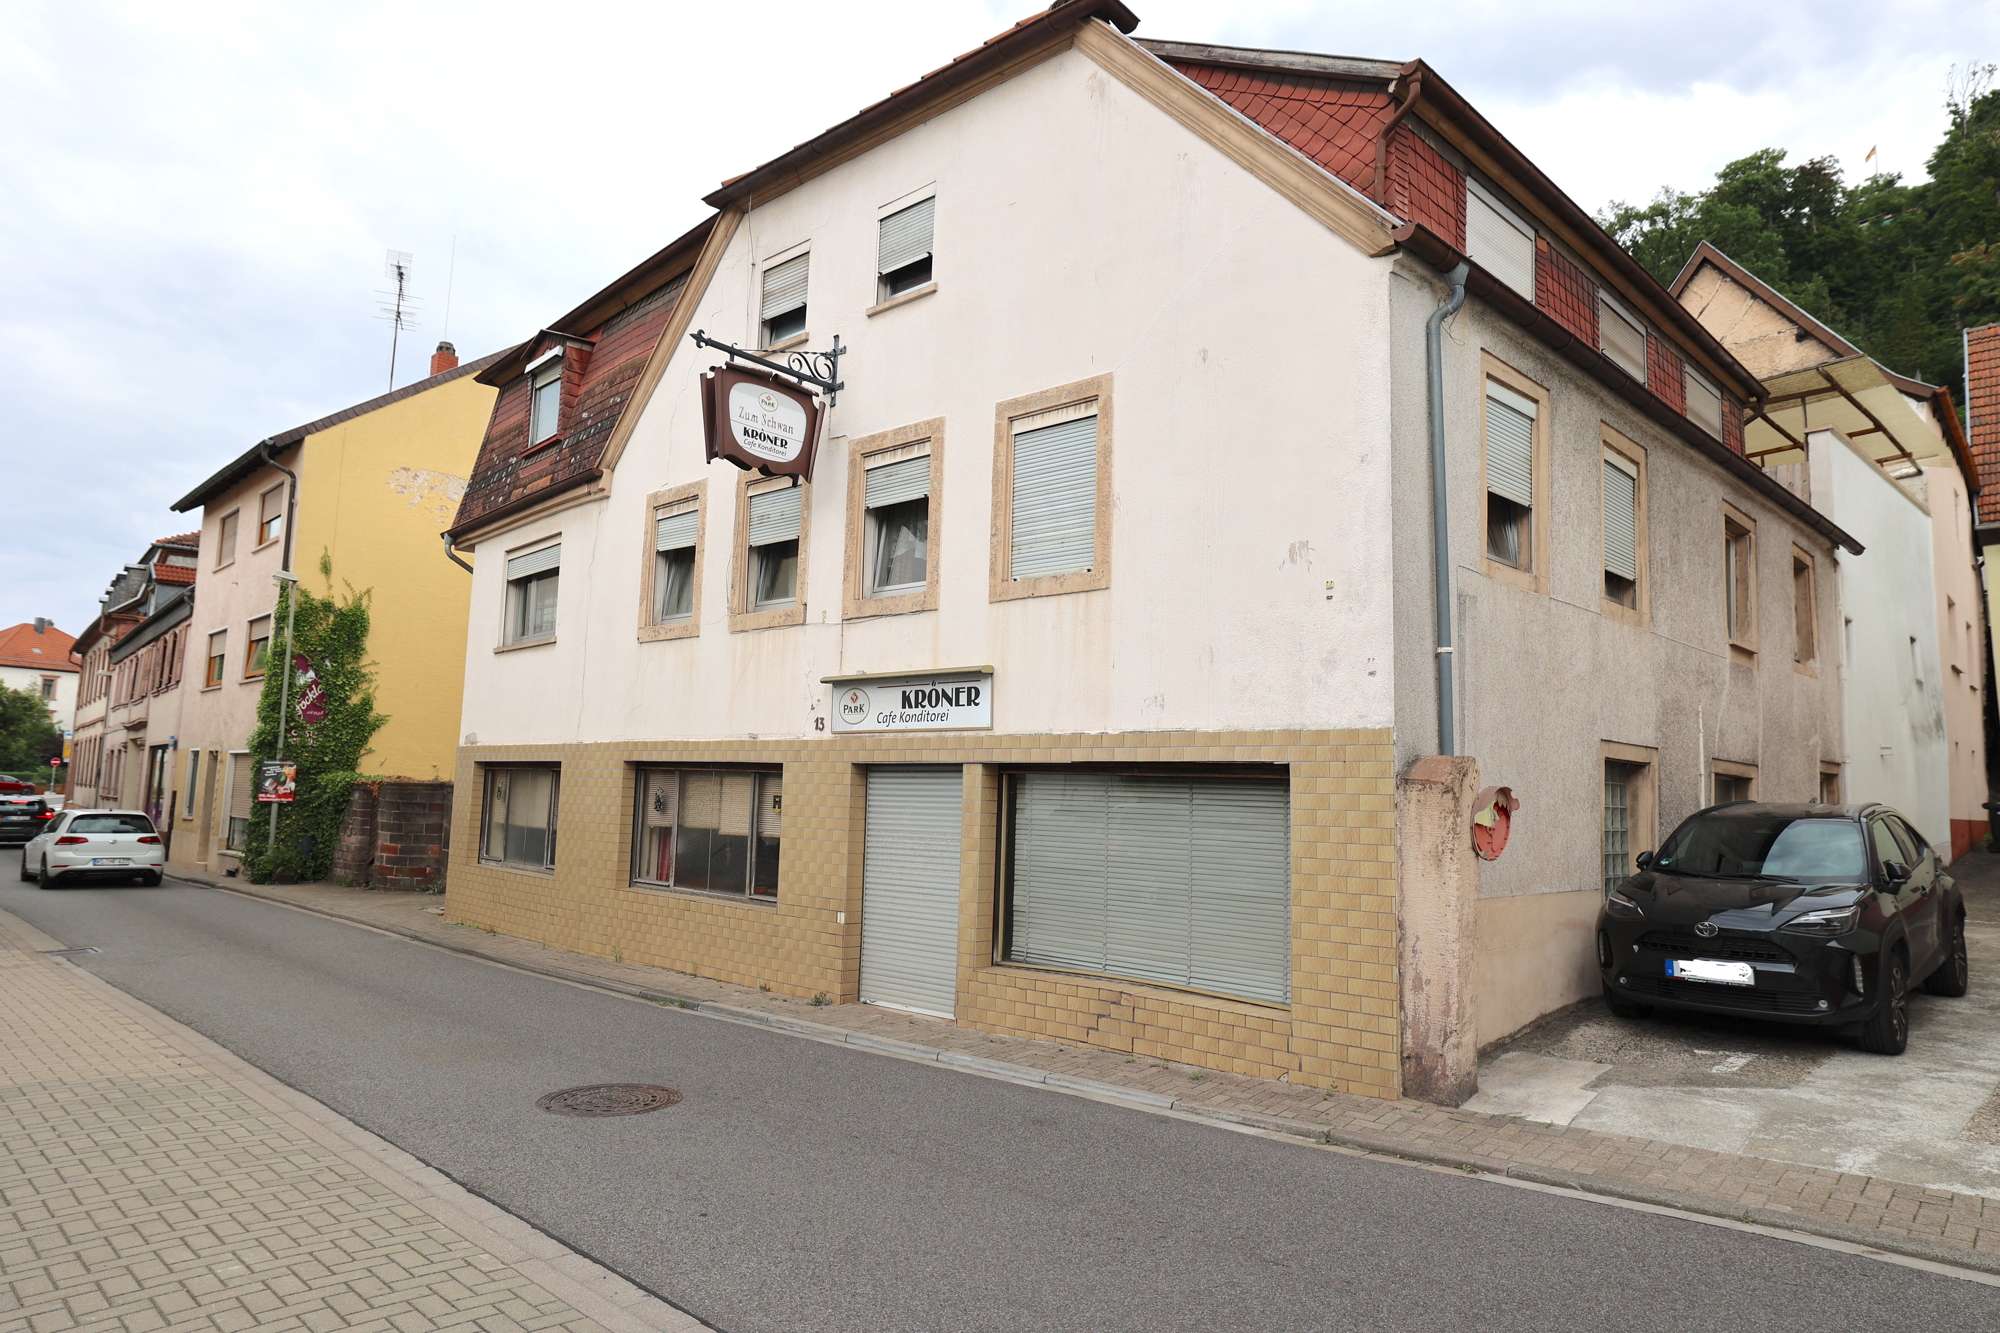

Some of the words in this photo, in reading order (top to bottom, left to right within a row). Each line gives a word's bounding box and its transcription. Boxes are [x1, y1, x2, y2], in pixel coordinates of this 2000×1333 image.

[738, 406, 759, 423] Zum
[761, 413, 794, 435] Schwan
[743, 426, 788, 450] KRÖNER
[757, 443, 787, 457] Konditorei
[901, 680, 981, 709] KRÖNER
[843, 703, 865, 714] PARK
[876, 710, 897, 727] Cafe
[899, 708, 950, 723] Konditorei
[814, 716, 825, 731] 13
